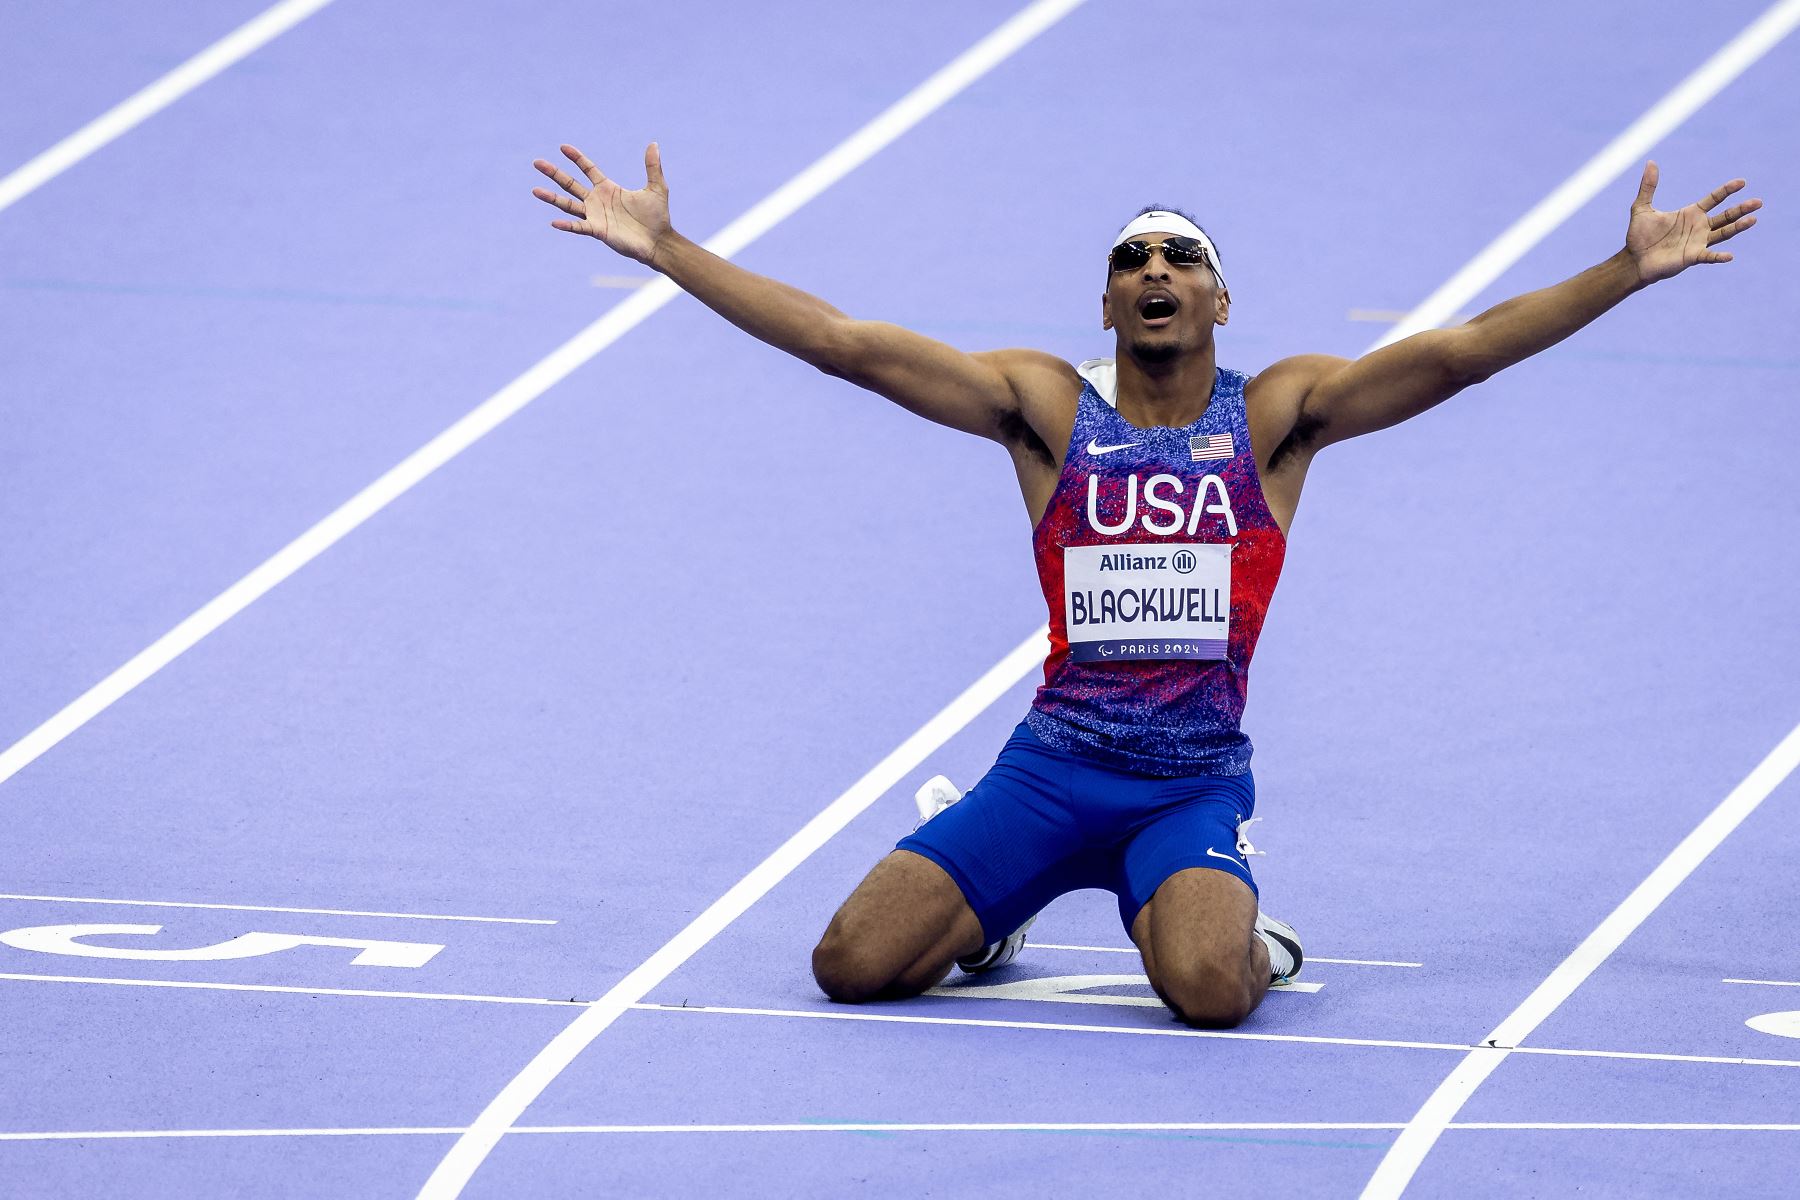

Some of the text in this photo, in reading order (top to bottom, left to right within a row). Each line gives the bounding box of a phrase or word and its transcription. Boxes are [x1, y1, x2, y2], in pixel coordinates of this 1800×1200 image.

[1087, 473, 1238, 537] USA
[1099, 553, 1168, 572] Allianz
[1071, 587, 1226, 626] BLACKWELL
[1120, 644, 1199, 655] PARIS 2024
[0, 923, 446, 968] 5
